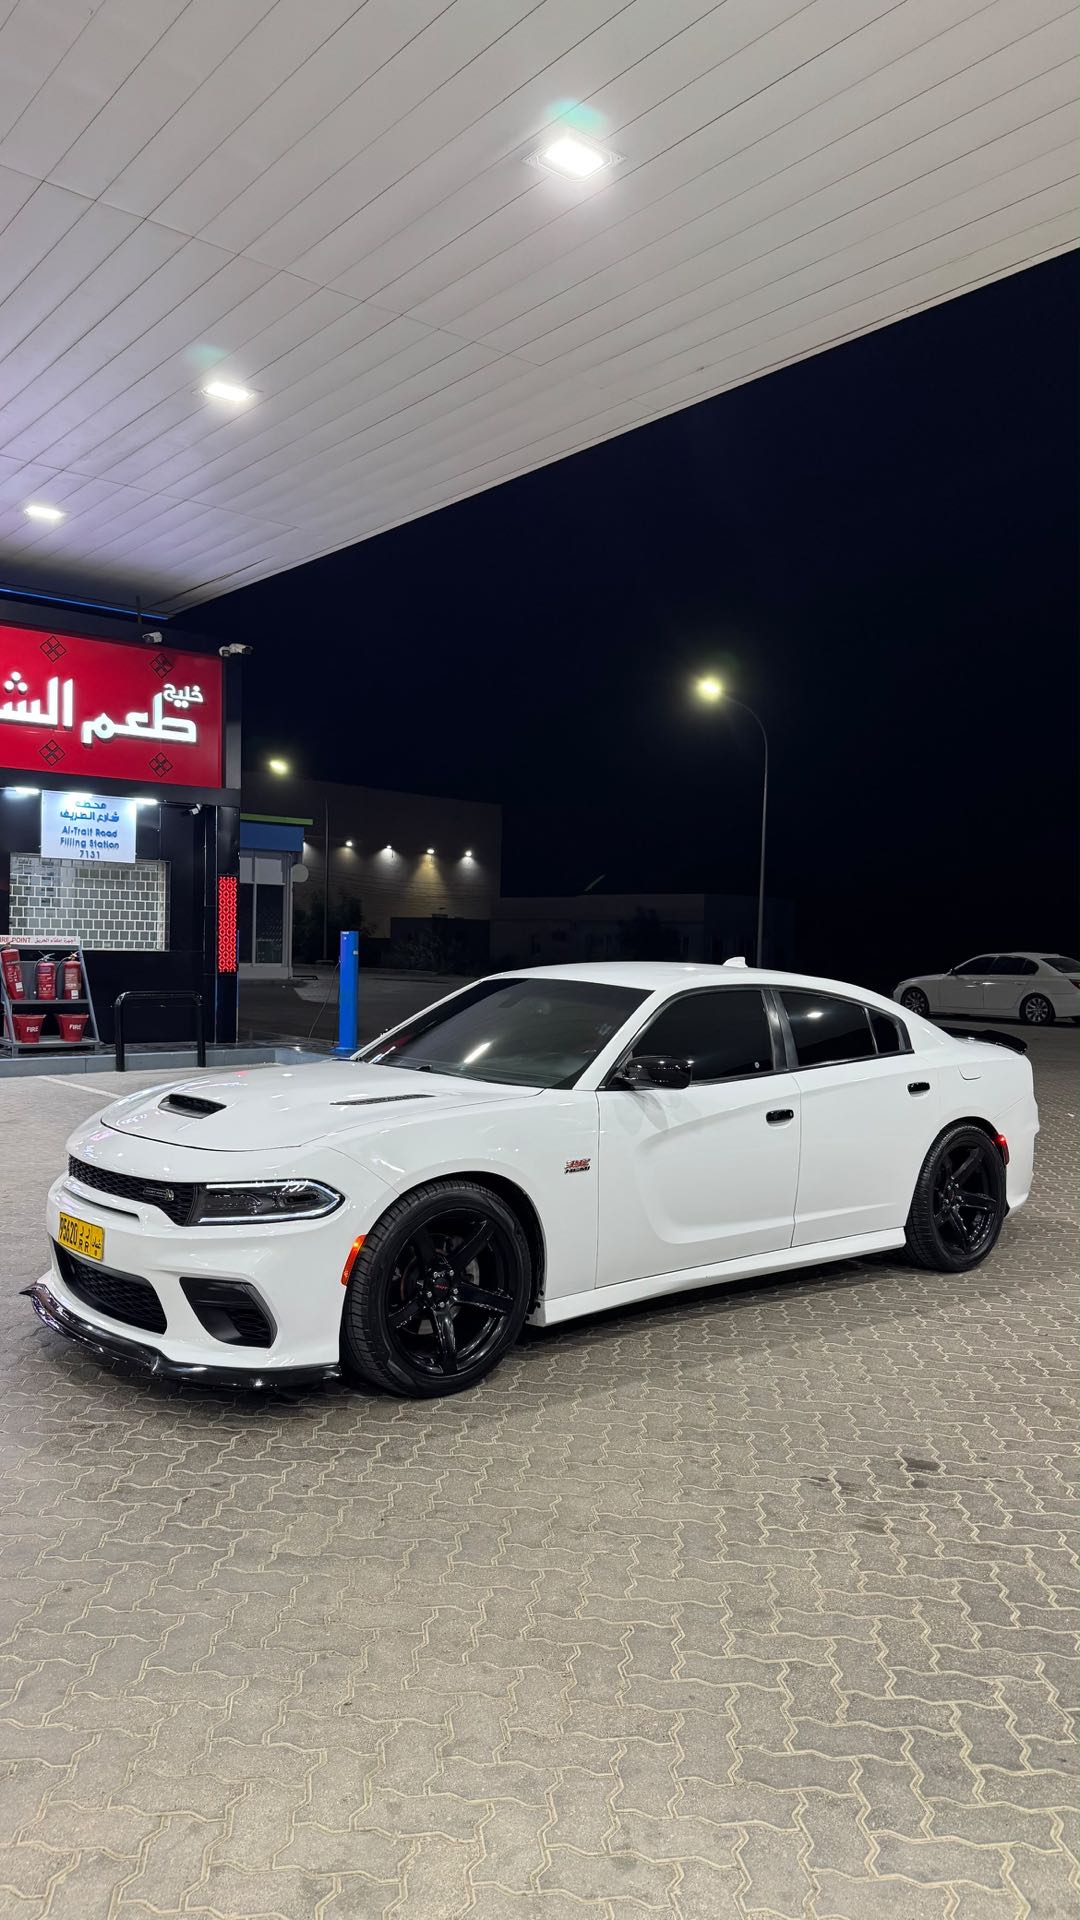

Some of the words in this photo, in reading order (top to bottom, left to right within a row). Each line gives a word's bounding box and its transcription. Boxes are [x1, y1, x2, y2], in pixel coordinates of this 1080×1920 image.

[0, 671, 73, 727] الش
[163, 683, 203, 708] خليج
[81, 692, 197, 744] طعم
[96, 811, 119, 822] شارع
[95, 828, 118, 838] Road
[60, 837, 87, 849] Filling
[89, 839, 119, 849] Station
[79, 849, 100, 859] 7131
